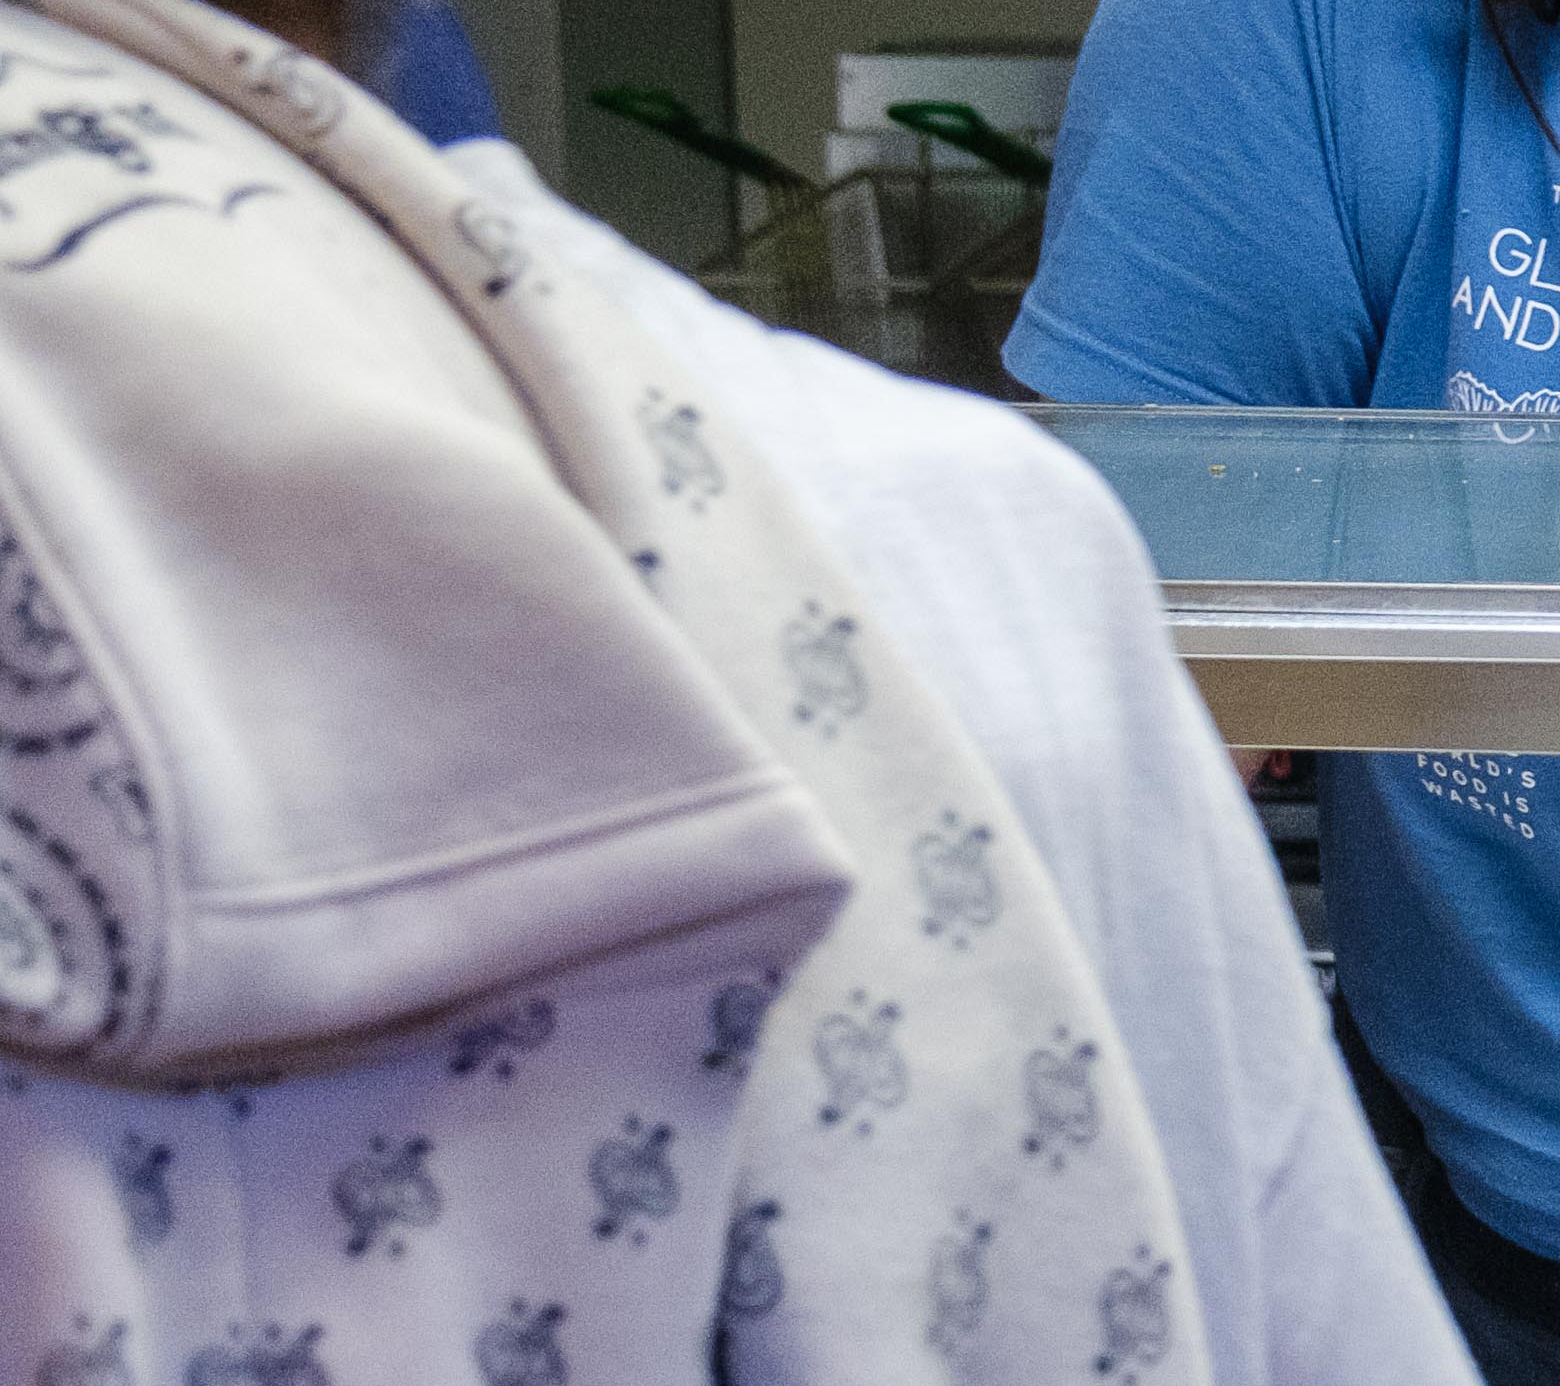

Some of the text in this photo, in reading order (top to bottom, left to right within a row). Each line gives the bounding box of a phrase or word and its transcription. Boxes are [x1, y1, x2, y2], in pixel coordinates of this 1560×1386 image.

[1416, 754, 1530, 814] FOOD IS
[1421, 778, 1536, 840] WASTED
